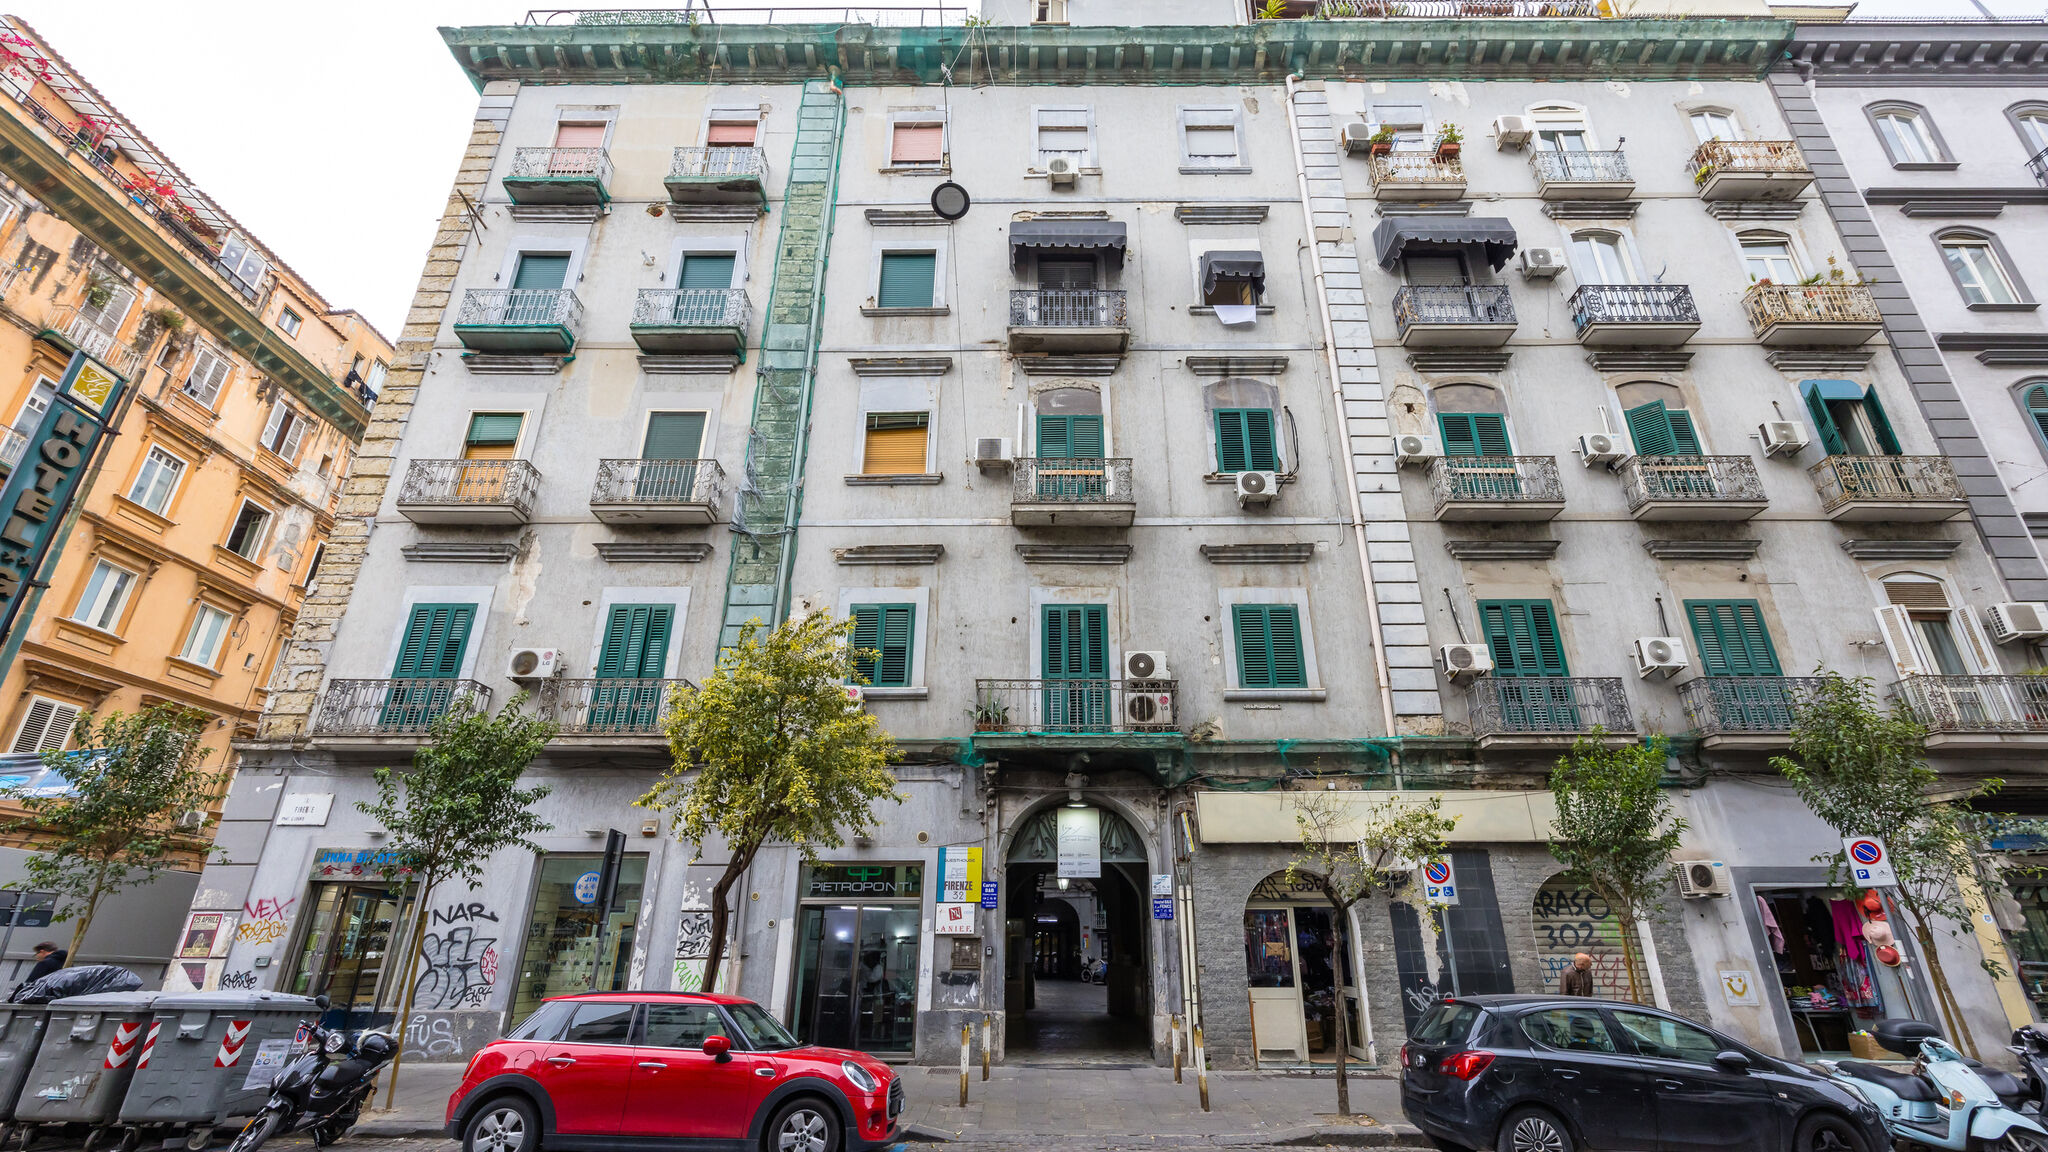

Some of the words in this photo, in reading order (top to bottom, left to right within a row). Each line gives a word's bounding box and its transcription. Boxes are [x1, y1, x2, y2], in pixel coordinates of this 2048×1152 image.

[1, 410, 95, 550] HOTEL
[319, 852, 353, 863] JINMA
[810, 882, 913, 892] PIETROPONTI
[944, 881, 973, 891] FIRENZE
[952, 891, 964, 900] 32
[201, 916, 220, 924] APRILE
[940, 925, 972, 933] ANIEF
[1540, 920, 1605, 950] 302
